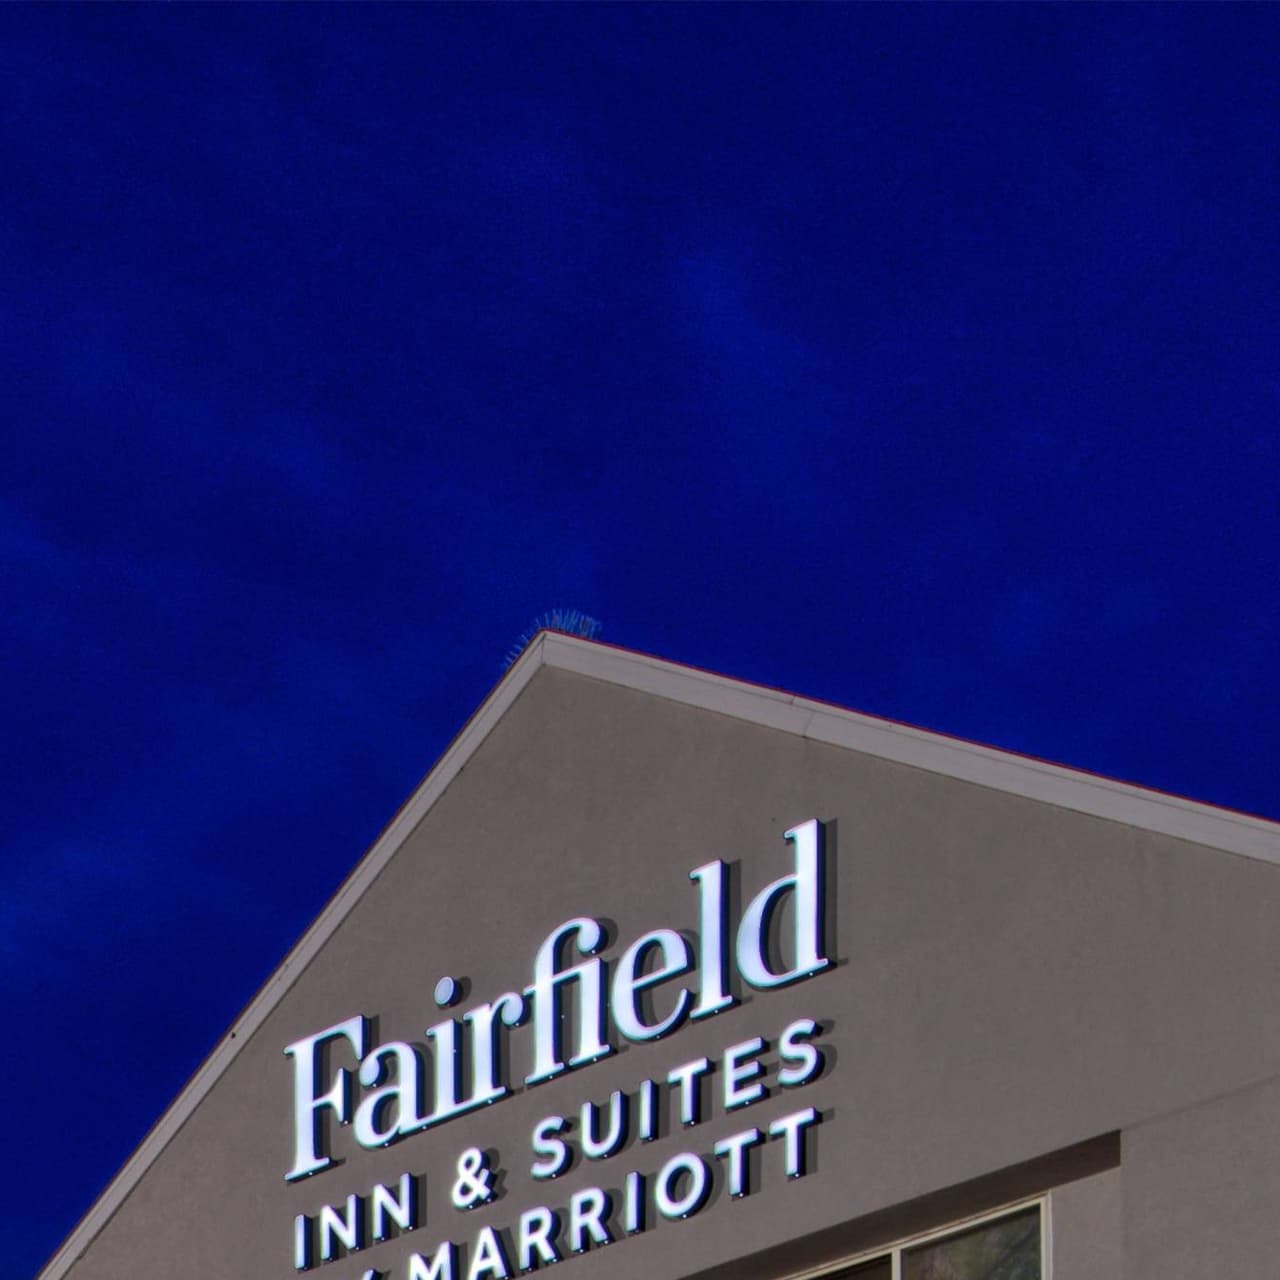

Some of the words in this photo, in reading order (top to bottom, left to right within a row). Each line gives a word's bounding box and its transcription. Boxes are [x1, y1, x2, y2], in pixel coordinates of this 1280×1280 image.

[284, 817, 830, 1182] Fairfield
[294, 1172, 417, 1271] INN
[450, 1146, 493, 1209] &
[531, 1018, 823, 1179] SUITES
